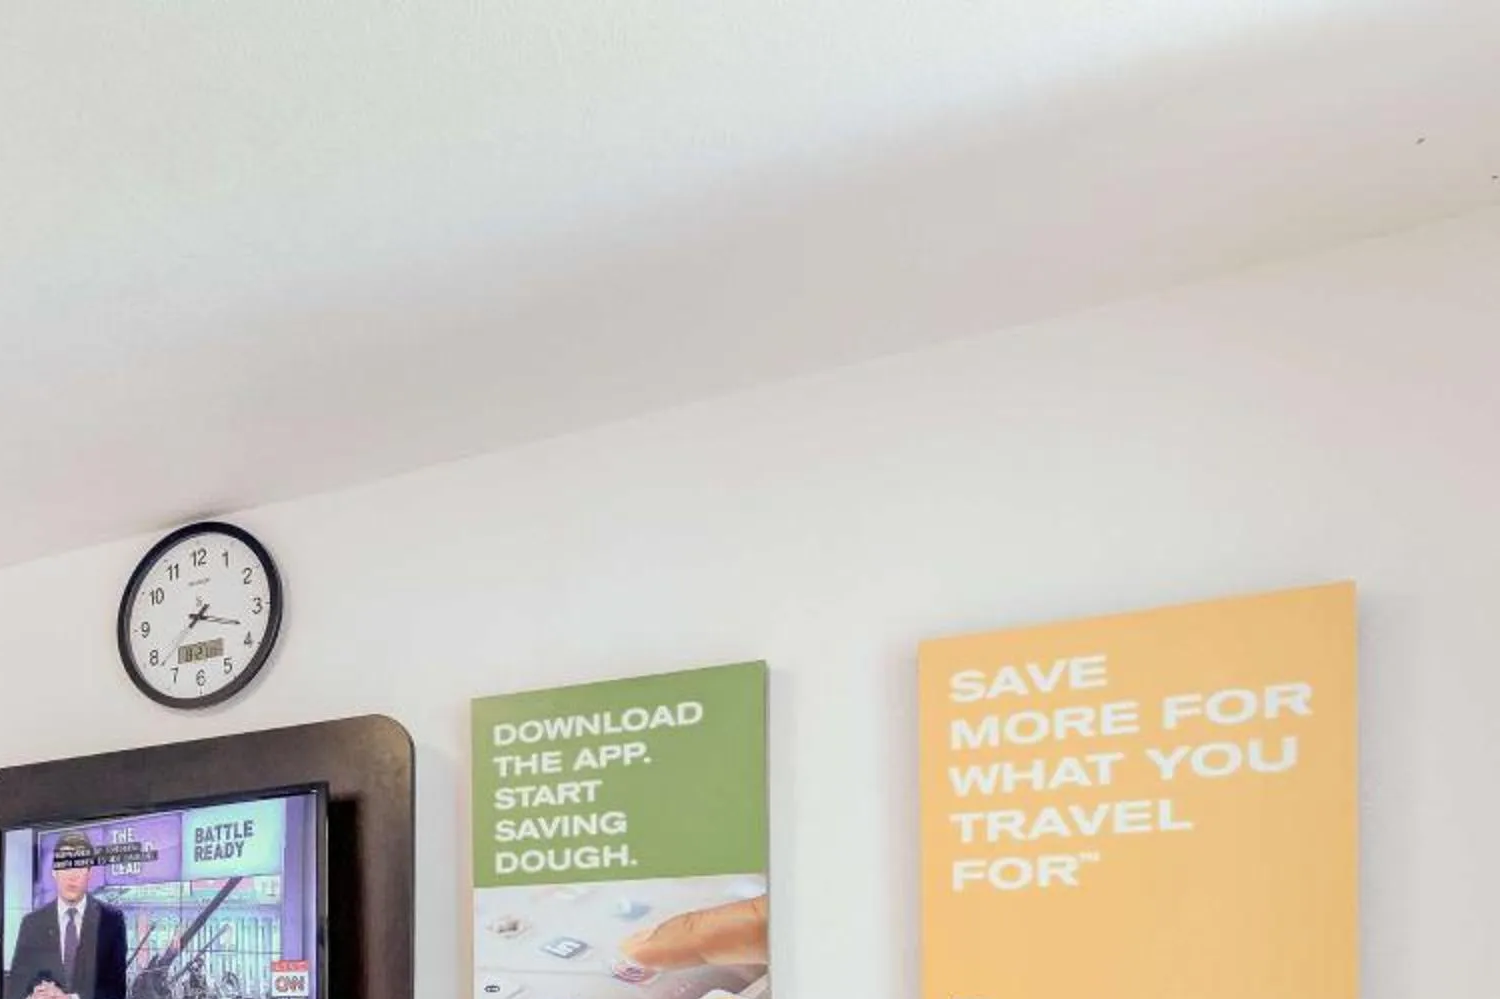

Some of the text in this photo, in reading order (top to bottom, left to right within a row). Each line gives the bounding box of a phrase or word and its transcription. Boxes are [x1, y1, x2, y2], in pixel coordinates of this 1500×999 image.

[190, 550, 208, 566] 12
[222, 552, 230, 567] 1
[167, 564, 180, 581] 11
[244, 567, 253, 584] 2
[150, 588, 165, 606] 10
[252, 598, 263, 614] 3
[141, 622, 150, 638] 9
[243, 632, 253, 645] 4
[150, 650, 159, 666] 8
[224, 658, 232, 674] 5
[170, 668, 179, 683] 7
[196, 670, 206, 686] 6
[949, 654, 1108, 703] SAVE
[492, 701, 703, 746] DOWNLOAD
[950, 681, 1314, 750] MORE FOR
[493, 742, 652, 778] THE APP.
[948, 736, 1298, 796] WHAT YOU
[494, 779, 603, 810] START
[494, 811, 628, 842] SAVING
[948, 799, 1194, 844] TRAVEL
[112, 828, 136, 843] THE
[194, 820, 253, 844] BATTLE
[194, 840, 244, 863] READY
[495, 844, 638, 874] DOUGH.
[275, 976, 308, 994] CNN
